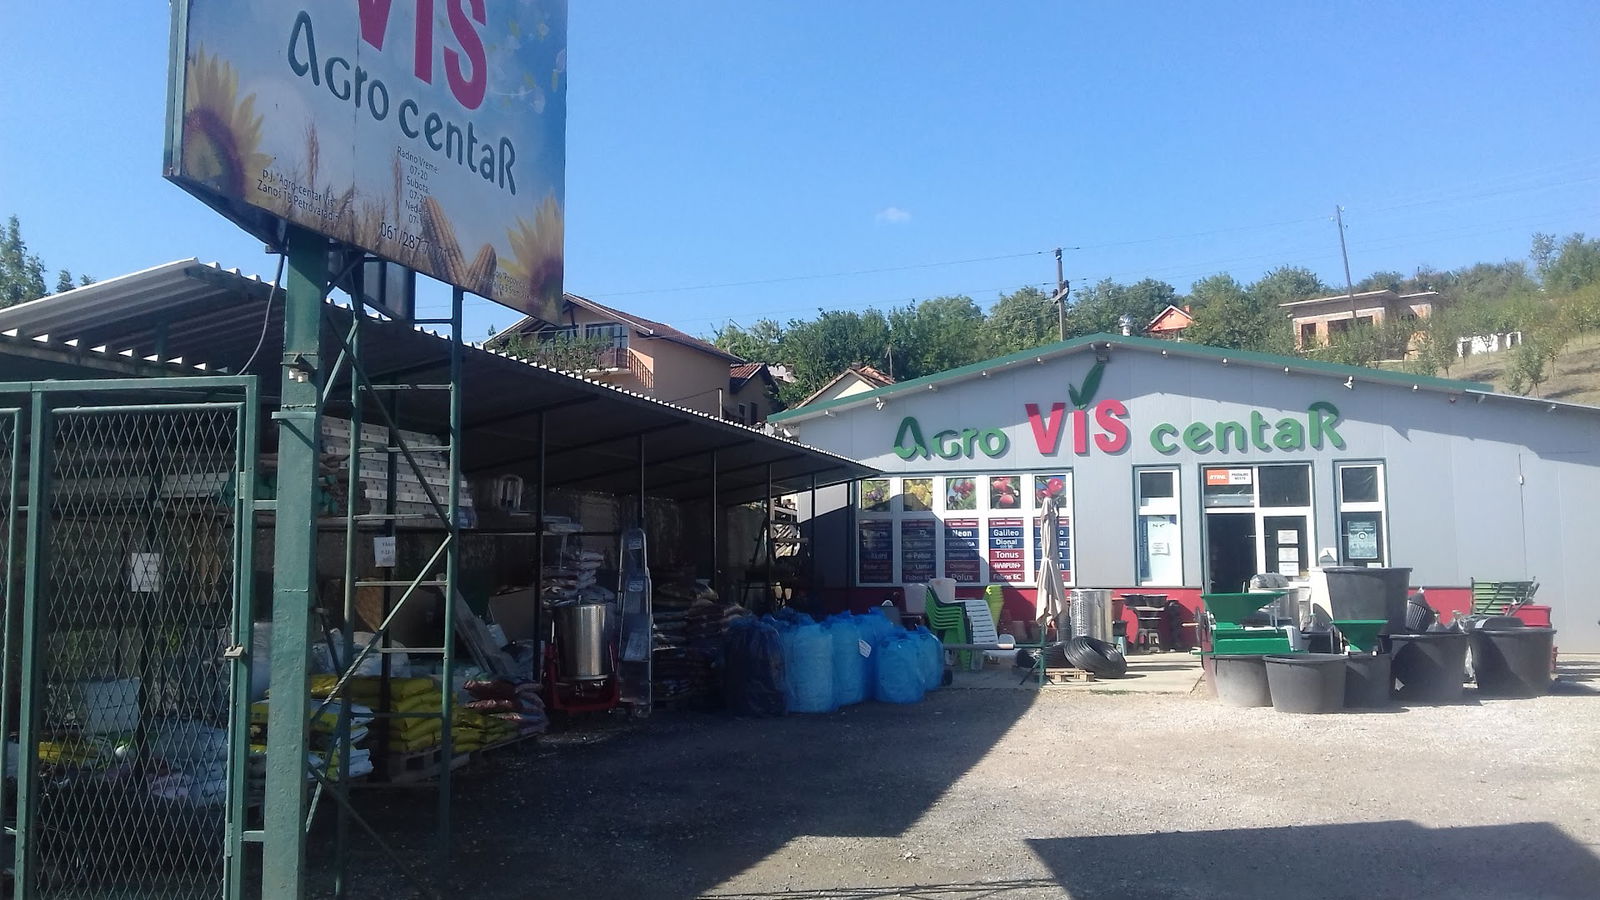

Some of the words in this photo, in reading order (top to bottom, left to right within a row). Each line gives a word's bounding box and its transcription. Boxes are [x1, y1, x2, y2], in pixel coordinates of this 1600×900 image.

[397, 146, 418, 164] Radno
[1026, 397, 1131, 455] VIS
[951, 529, 973, 537] Neon
[993, 529, 1020, 537] Galileo
[994, 550, 1020, 559] Tonus
